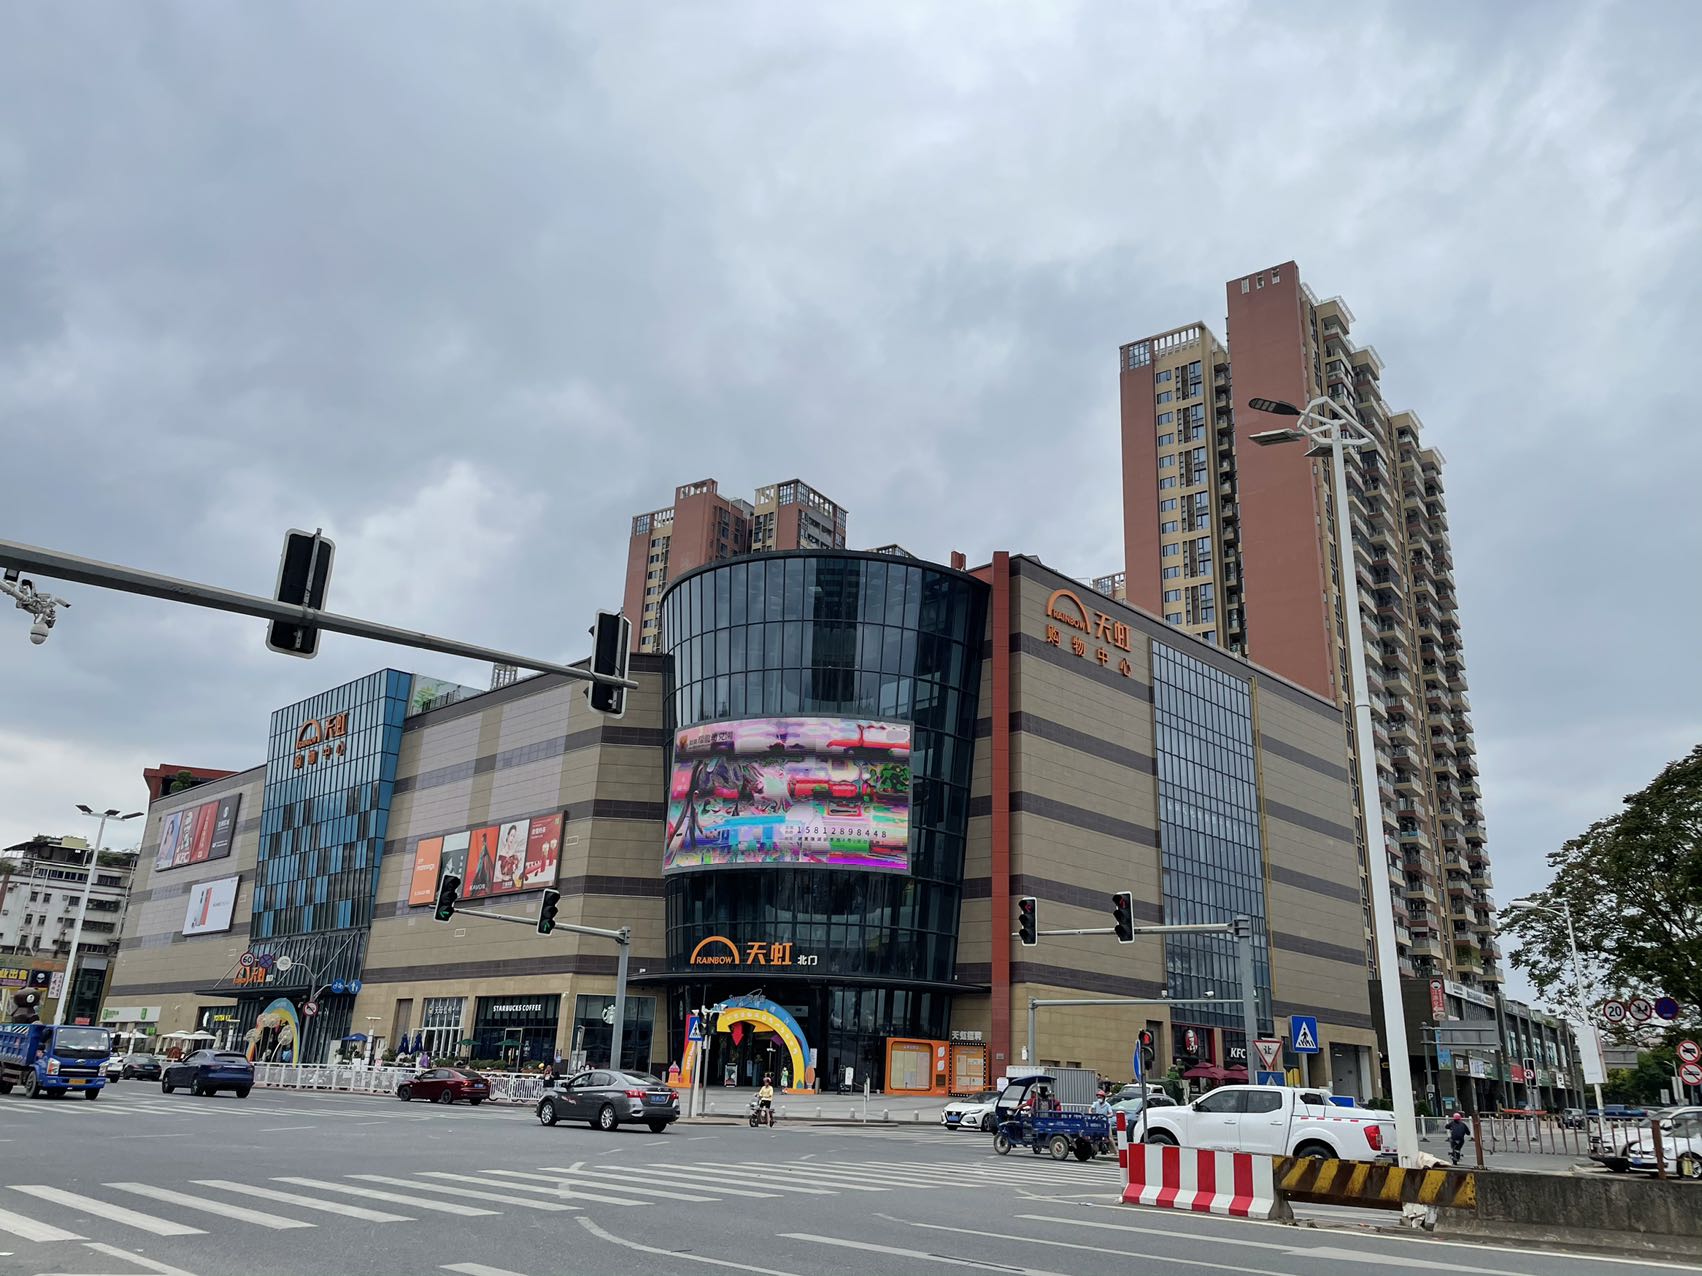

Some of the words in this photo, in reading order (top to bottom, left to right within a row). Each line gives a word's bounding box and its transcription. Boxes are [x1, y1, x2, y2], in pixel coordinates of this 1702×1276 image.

[1052, 608, 1087, 631] RAINBOW
[1094, 611, 1132, 653] 天虹
[1046, 623, 1133, 678] 购物中心
[696, 956, 733, 965] RAINBOW
[746, 942, 794, 965] 天虹
[797, 955, 818, 966] 北门
[1608, 1006, 1622, 1017] 20
[1230, 1047, 1247, 1059] KFC
[1263, 1045, 1272, 1055] 让
